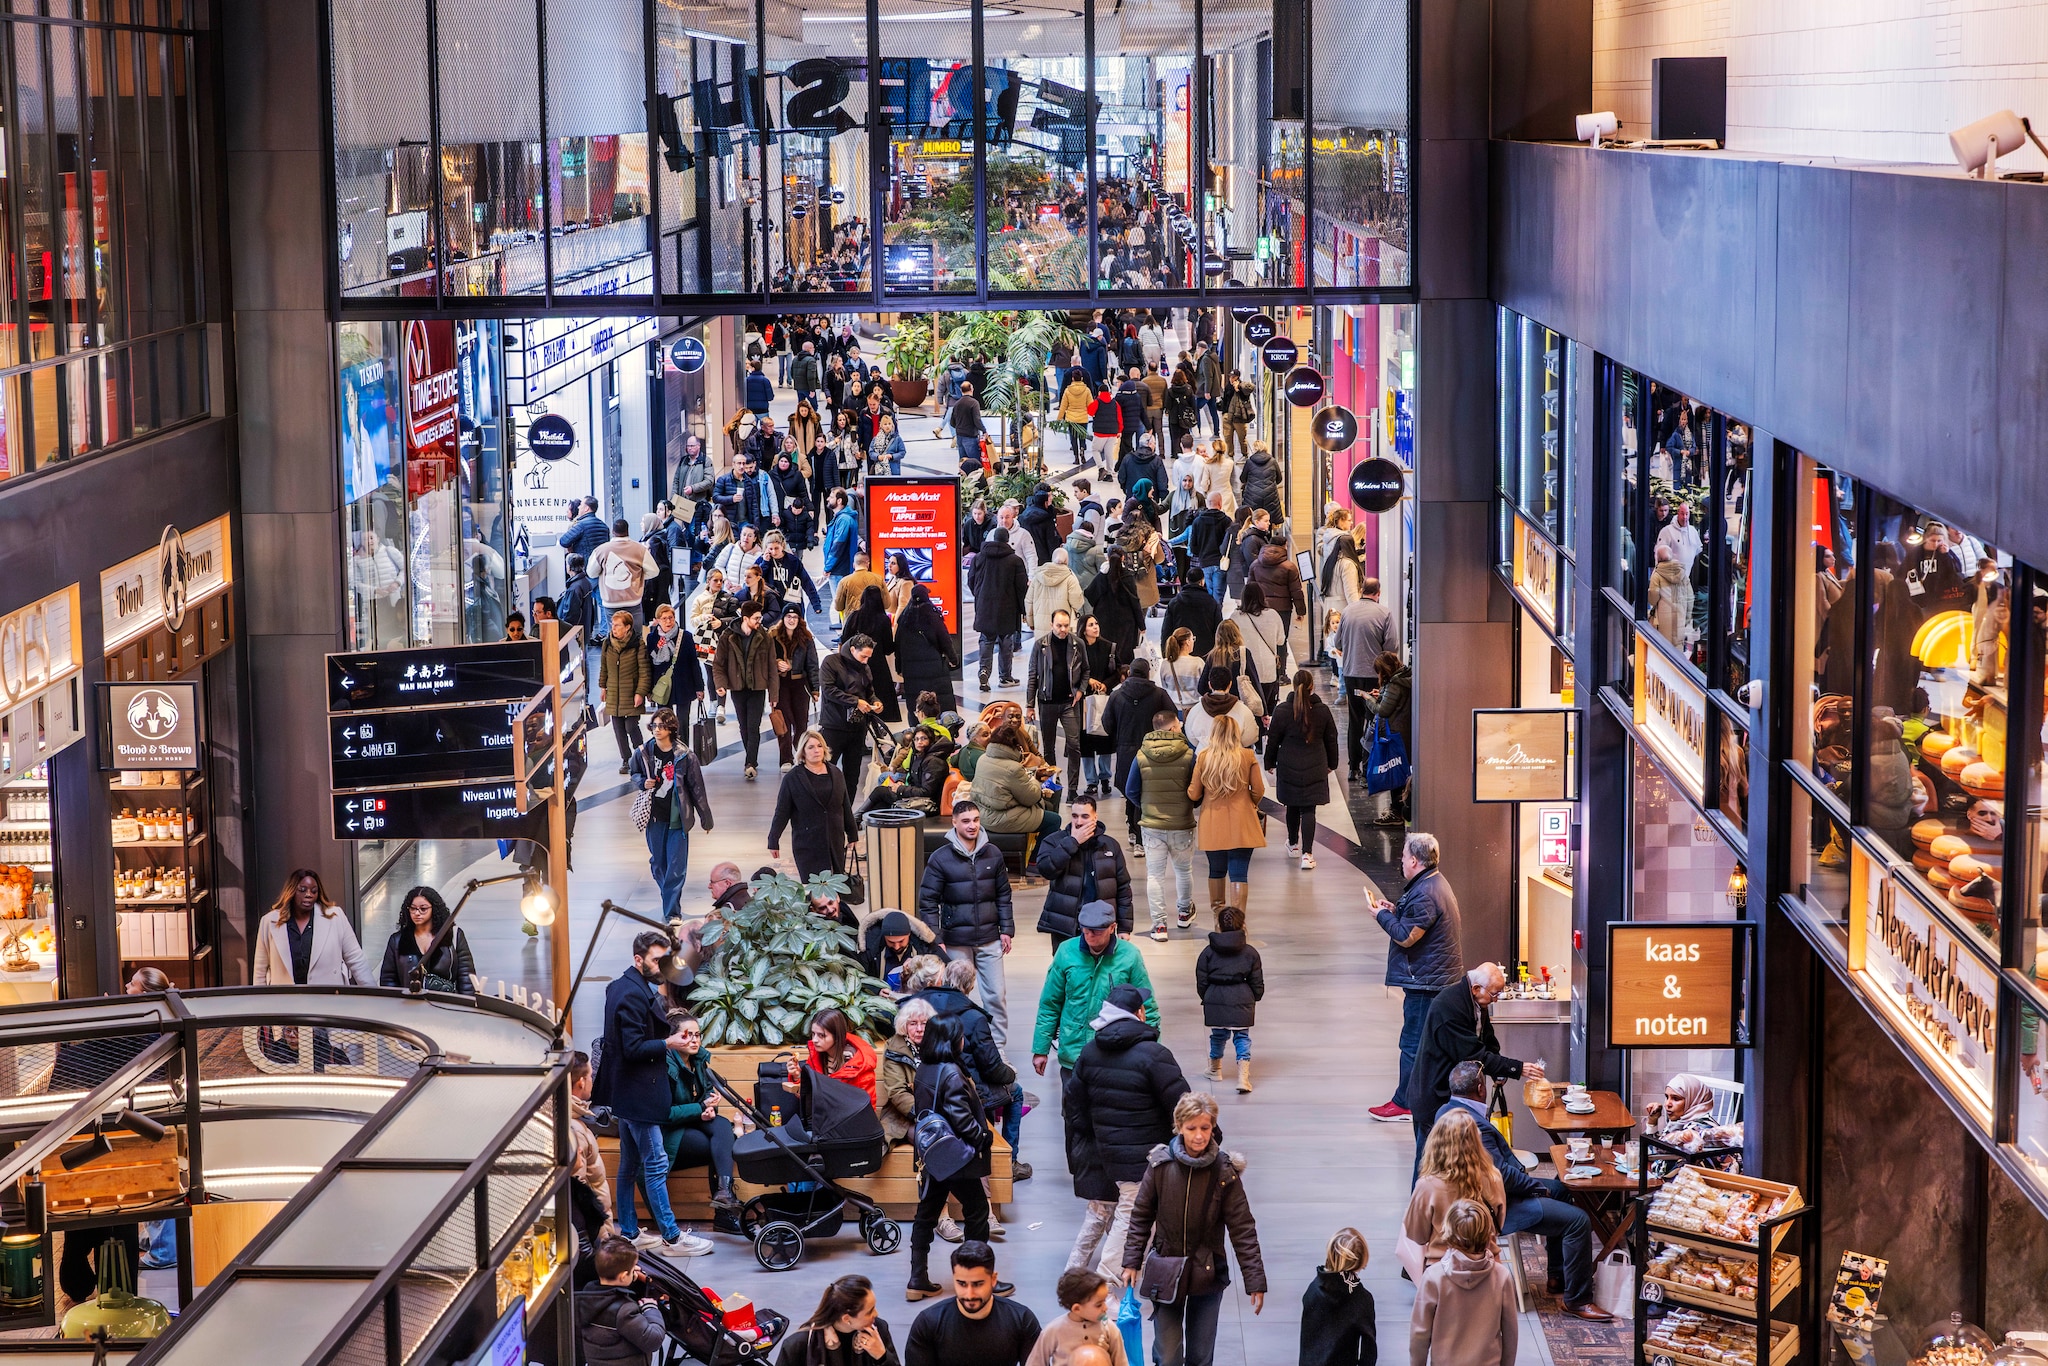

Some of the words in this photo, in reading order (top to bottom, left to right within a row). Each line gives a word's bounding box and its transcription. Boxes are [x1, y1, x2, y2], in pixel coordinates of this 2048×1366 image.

[923, 141, 960, 153] JUMBO
[365, 361, 384, 384] SENTO
[538, 430, 566, 441] Westfield
[1355, 481, 1381, 489] Modern
[1382, 481, 1399, 489] Nails
[896, 512, 916, 520] APPLE
[186, 549, 212, 582] Brown
[115, 574, 144, 618] Blond
[399, 682, 415, 691] WAH
[416, 681, 432, 690] NAM
[433, 680, 454, 689] HONG
[117, 745, 147, 755] Blond
[148, 744, 157, 754] &
[158, 745, 192, 755] Brown
[1378, 756, 1403, 774] ACTION
[463, 790, 496, 802] Niveau
[496, 788, 501, 799] 1
[486, 807, 520, 819] Ingang
[375, 818, 385, 827] 19
[1550, 817, 1560, 829] B
[1646, 936, 1700, 961] kaas
[1875, 877, 1995, 1054] Alexanderhoeve
[1662, 974, 1682, 999] &
[1635, 1013, 1707, 1035] noten
